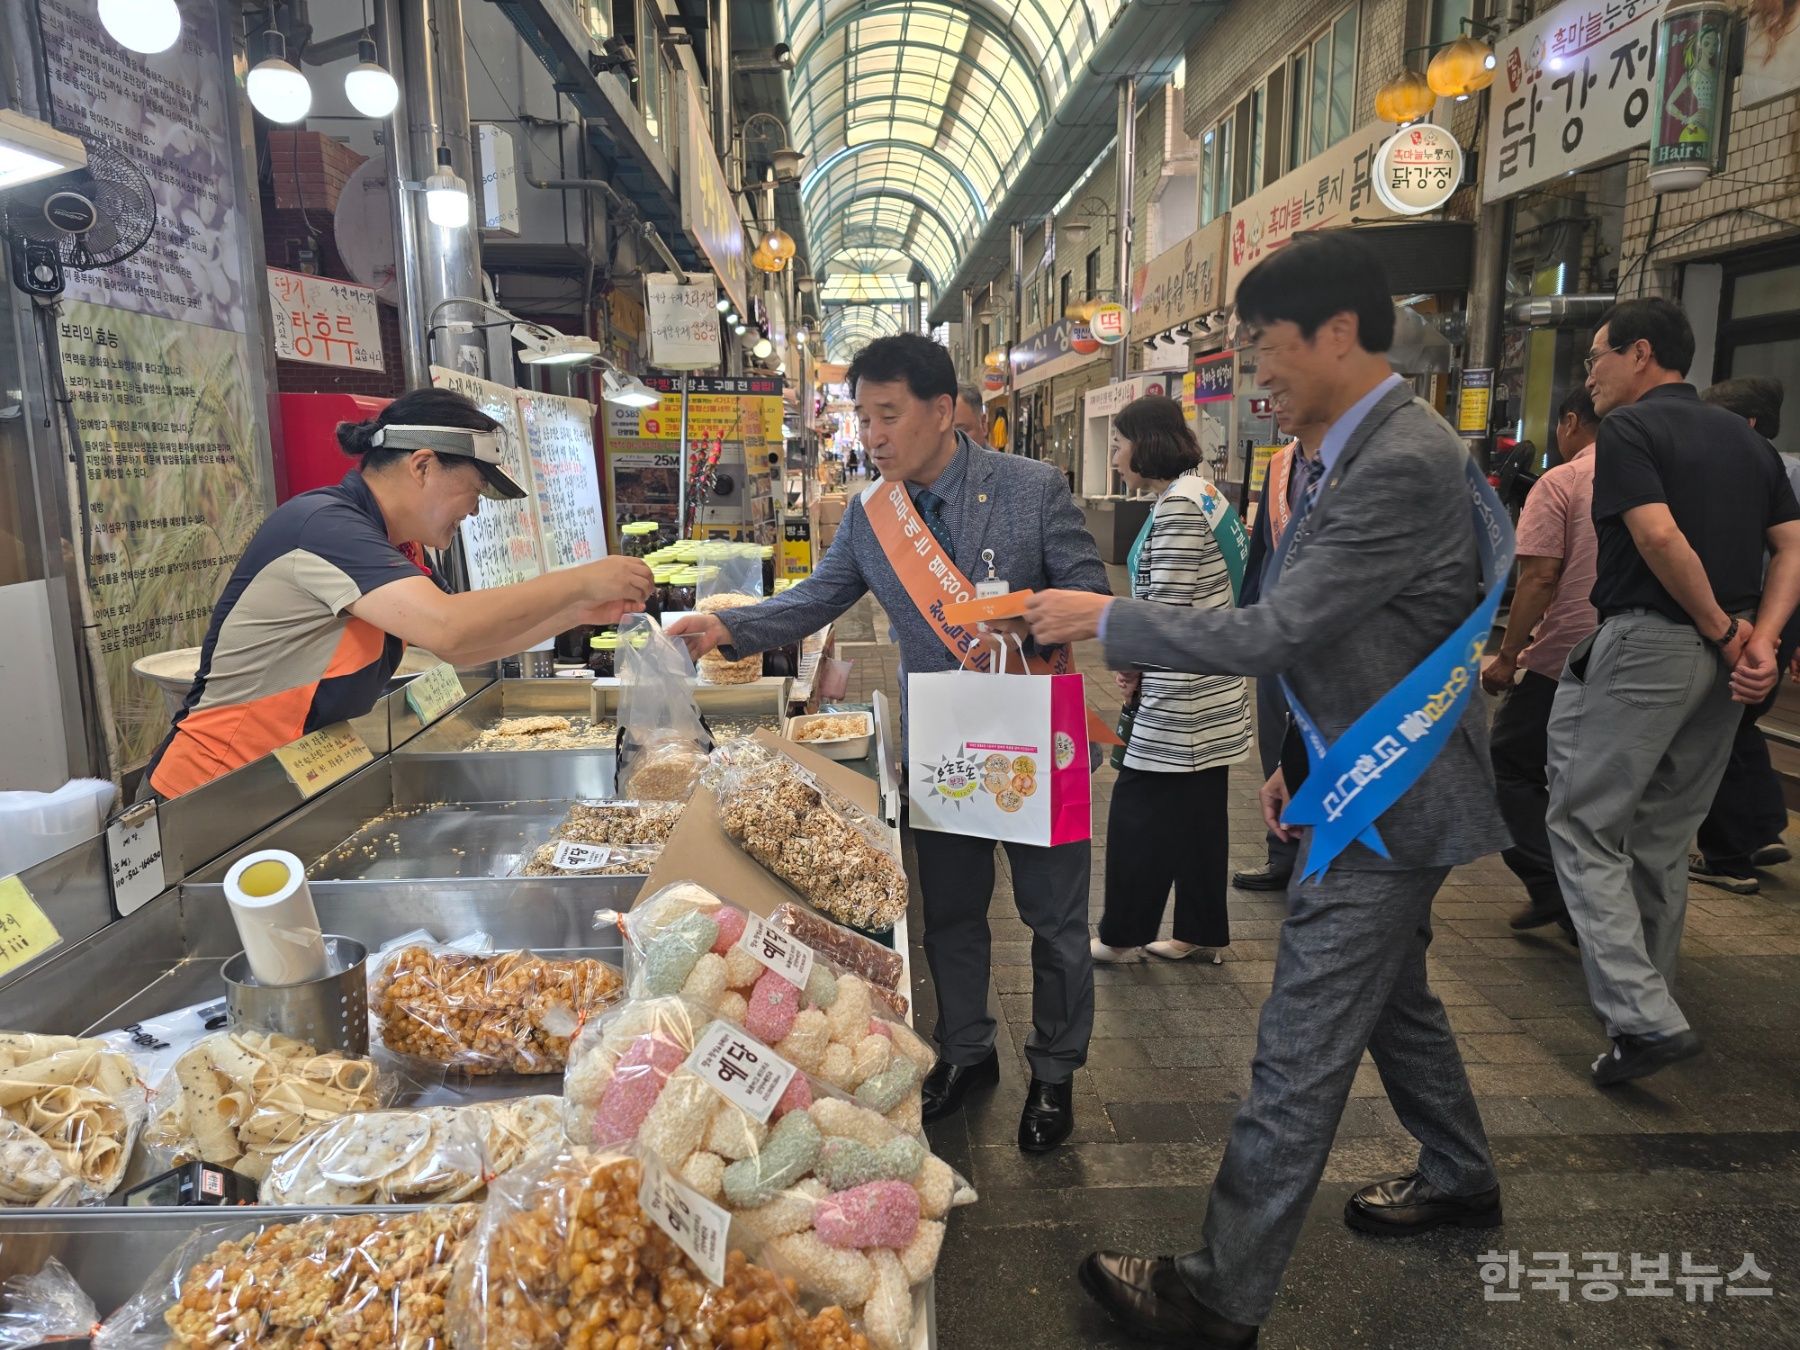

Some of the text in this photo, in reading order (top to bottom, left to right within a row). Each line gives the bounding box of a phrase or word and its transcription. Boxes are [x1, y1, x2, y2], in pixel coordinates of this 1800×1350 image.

[1499, 19, 1658, 182] 닭강정
[1394, 149, 1454, 161] 흑마늘누룽지
[1658, 143, 1691, 162] Hair
[1392, 166, 1451, 189] 닭강정
[1267, 168, 1345, 235] 흑마늘누룽지
[274, 275, 305, 305] 딸기
[61, 322, 118, 349] 보리의 효능
[1100, 311, 1123, 335] 떡
[291, 311, 360, 365] 탕후루
[70, 376, 91, 388] 보리가
[90, 502, 104, 513] 예방
[763, 925, 788, 960] 예당
[718, 1040, 759, 1083] 예당
